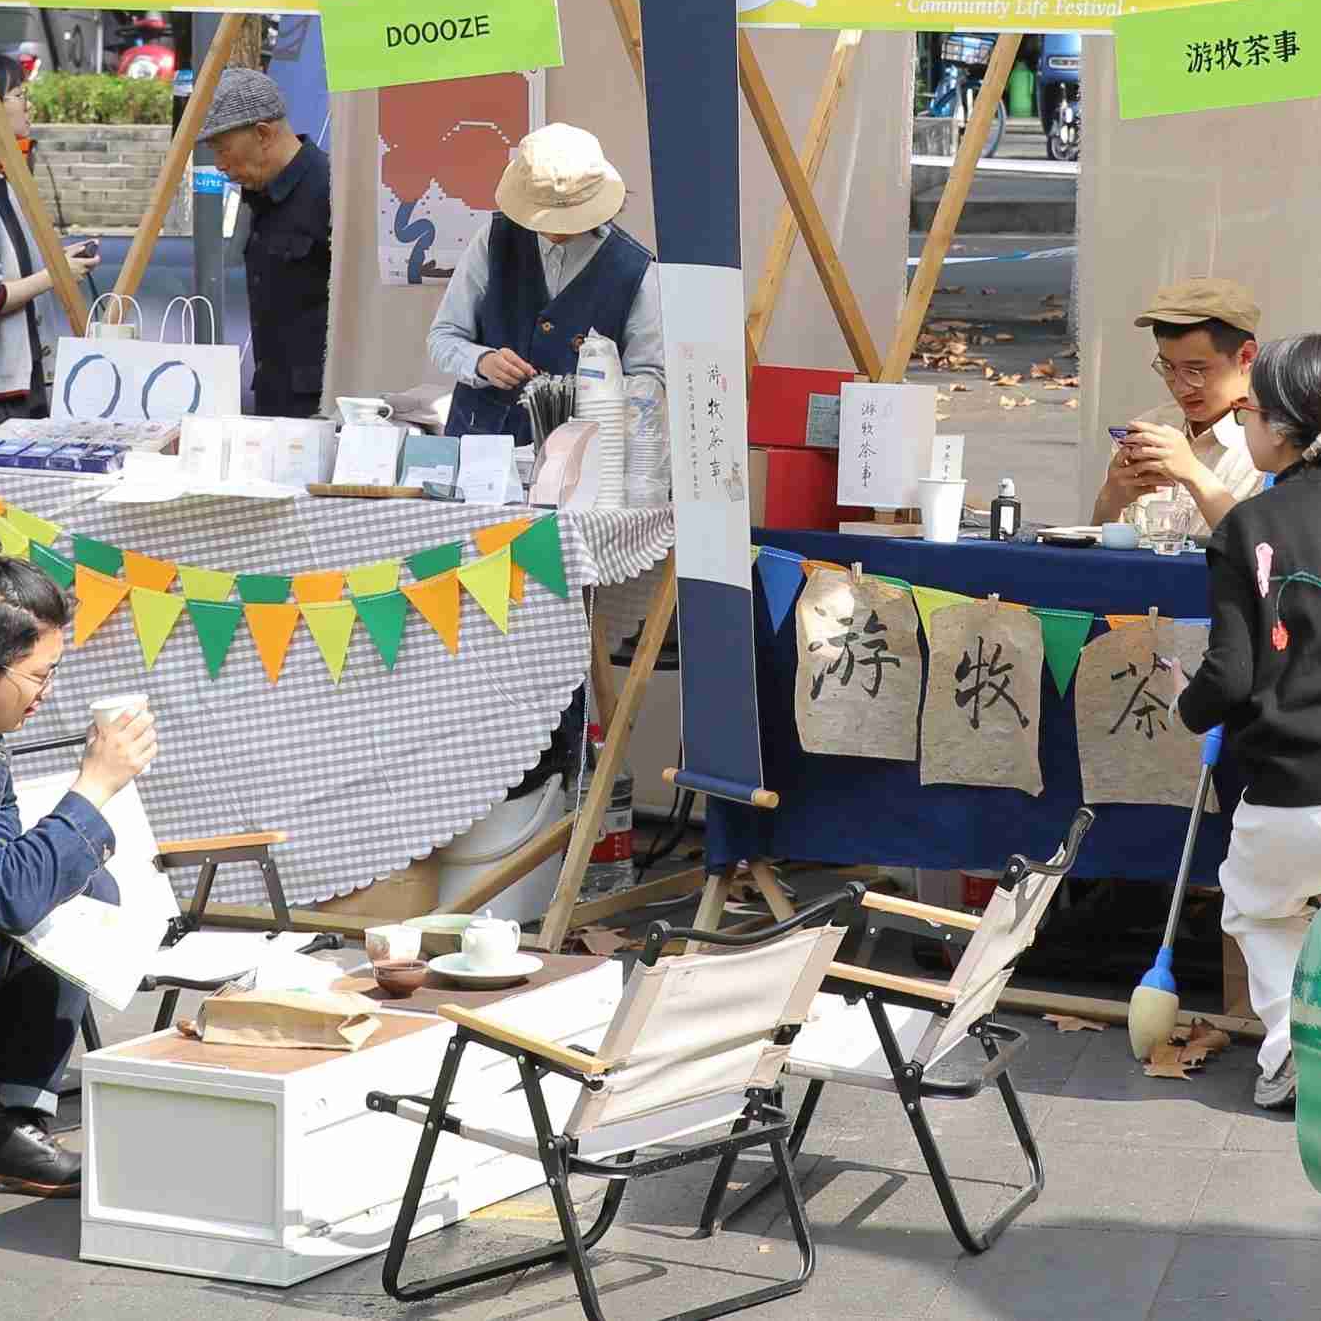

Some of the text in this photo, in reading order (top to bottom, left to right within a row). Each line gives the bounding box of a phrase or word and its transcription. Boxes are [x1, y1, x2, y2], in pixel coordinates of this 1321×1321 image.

[385, 15, 491, 48] DOOOZE
[1185, 29, 1301, 74] 游牧茶事
[809, 606, 901, 700] 游
[954, 635, 1030, 730] 牧
[1110, 651, 1189, 740] 茶
